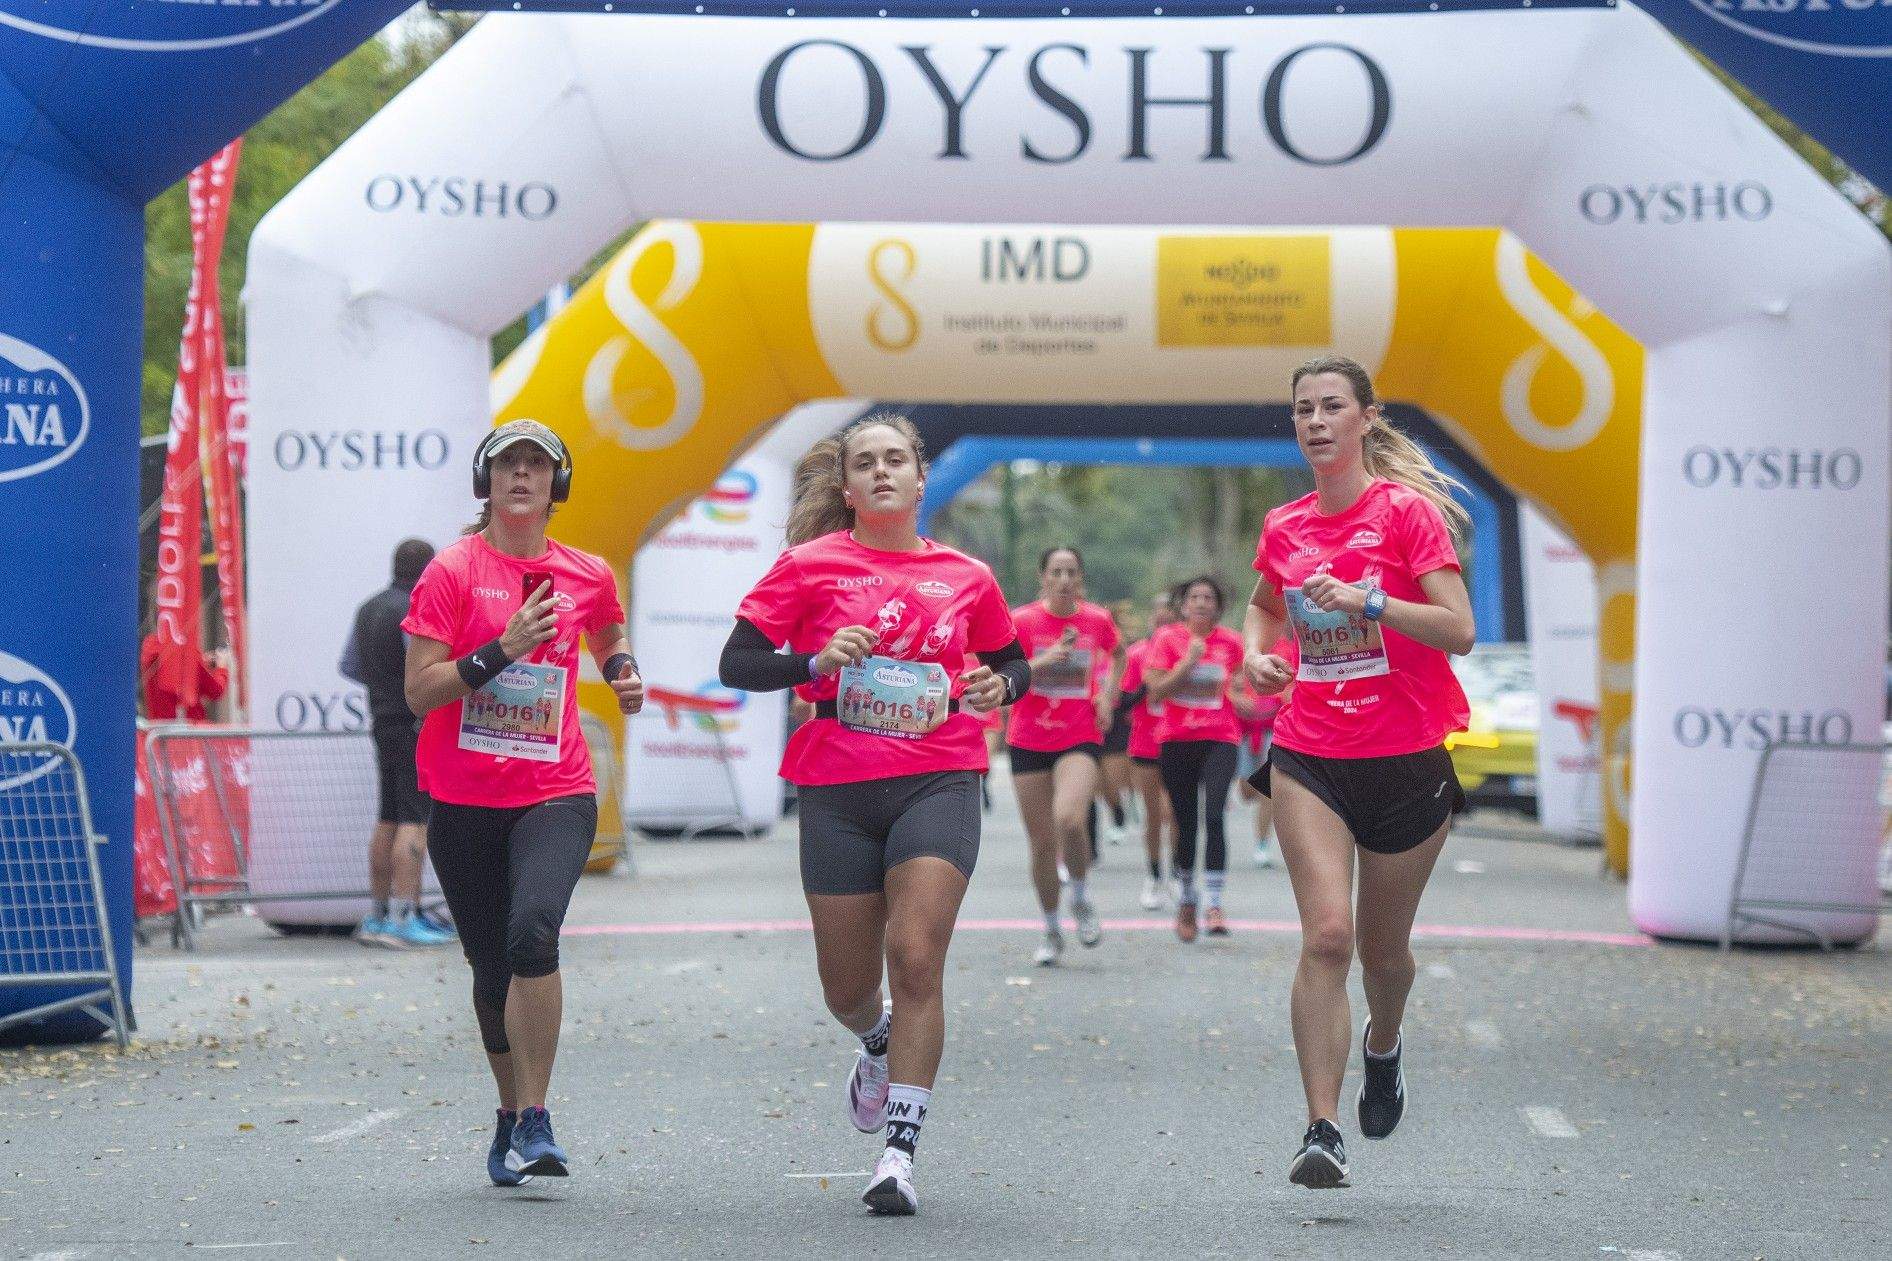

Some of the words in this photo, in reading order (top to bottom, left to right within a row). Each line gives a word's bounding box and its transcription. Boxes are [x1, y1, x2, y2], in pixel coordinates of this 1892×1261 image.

[756, 38, 1394, 166] OYSHO
[366, 174, 559, 221] OYSHO
[1580, 182, 1774, 226] OYSHO
[980, 237, 1091, 283] IMD
[274, 429, 450, 471] OYSHO
[1682, 446, 1863, 491] OYSHO
[472, 586, 510, 600] OYSHO
[837, 575, 883, 588] OYSHO
[1311, 626, 1349, 645] 016
[275, 690, 365, 735] OYS
[495, 703, 534, 721] 016
[872, 700, 913, 719] 016
[1673, 704, 1852, 750] OYSHO
[469, 737, 501, 750] OYSHO
[888, 1101, 912, 1117] UN
